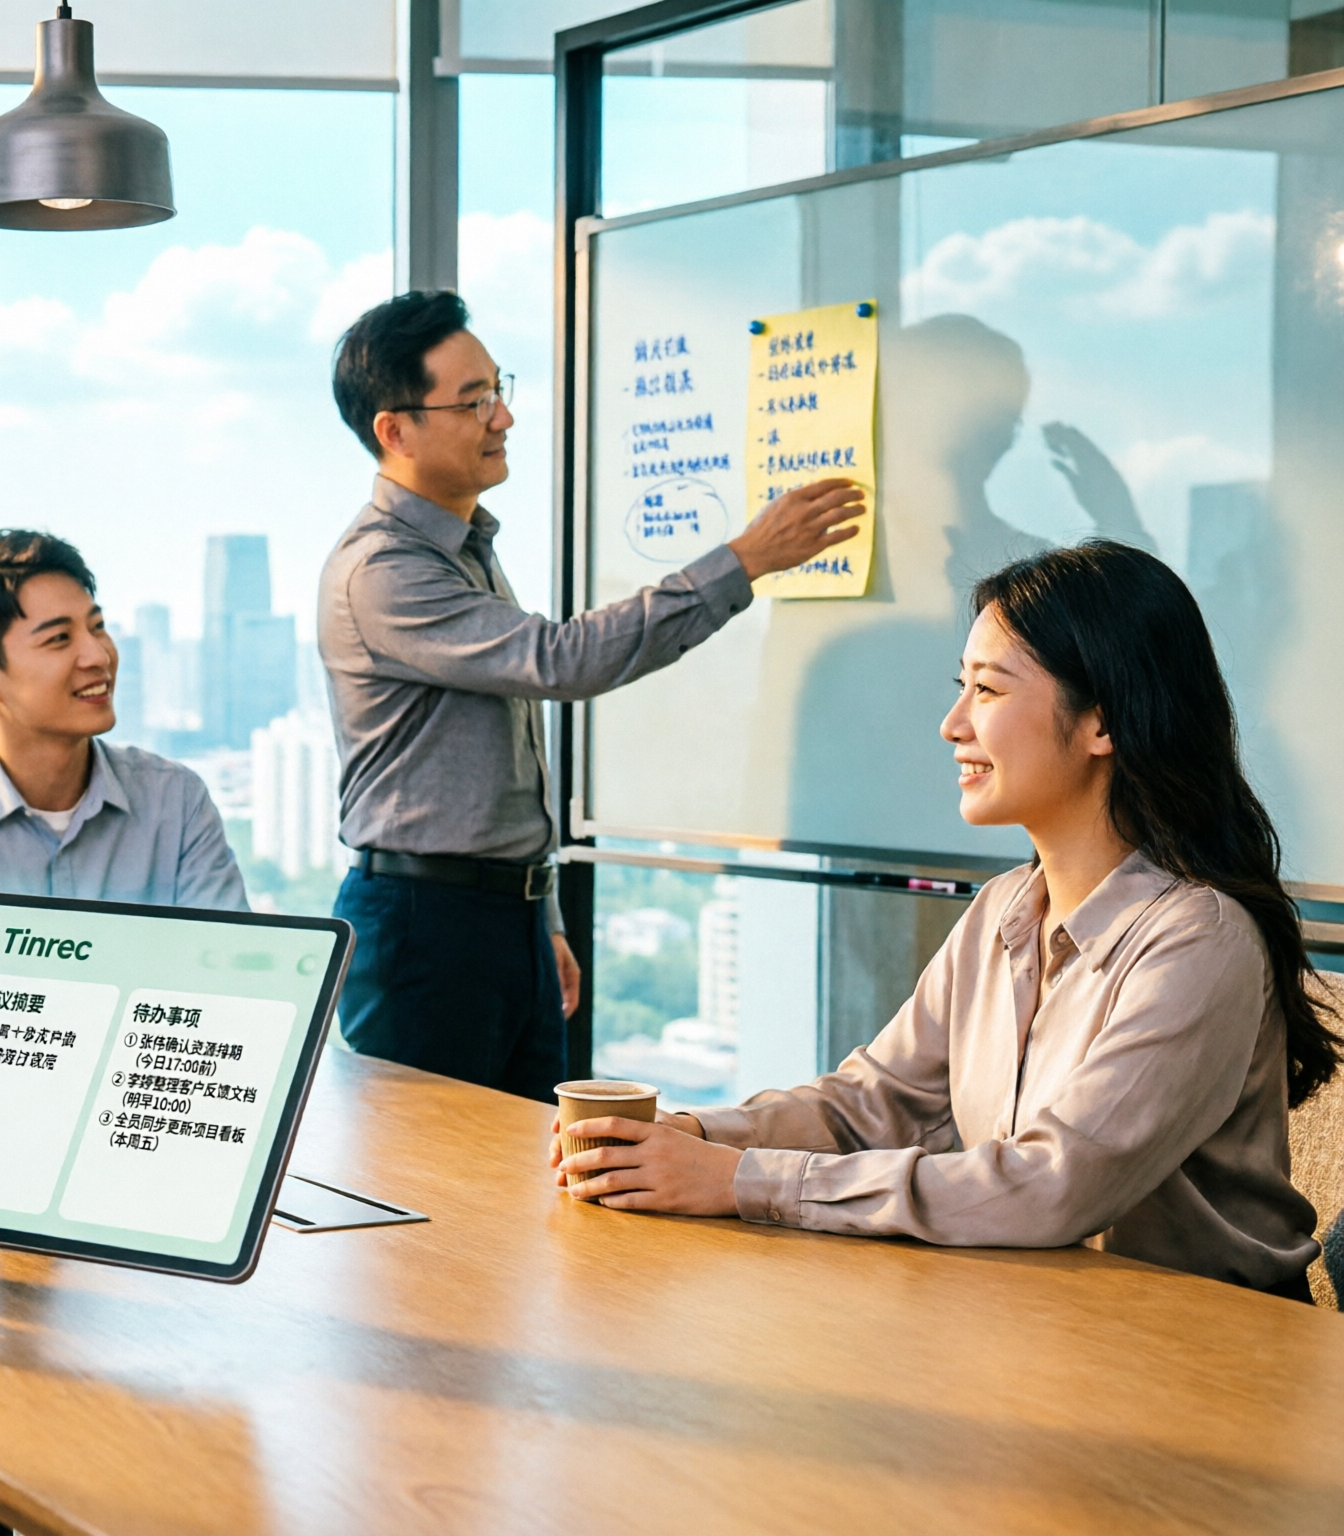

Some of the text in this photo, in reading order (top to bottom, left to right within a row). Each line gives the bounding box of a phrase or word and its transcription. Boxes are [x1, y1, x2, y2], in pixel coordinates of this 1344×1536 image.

[5, 928, 93, 961] Tinrec
[133, 1003, 202, 1028] 待办事项
